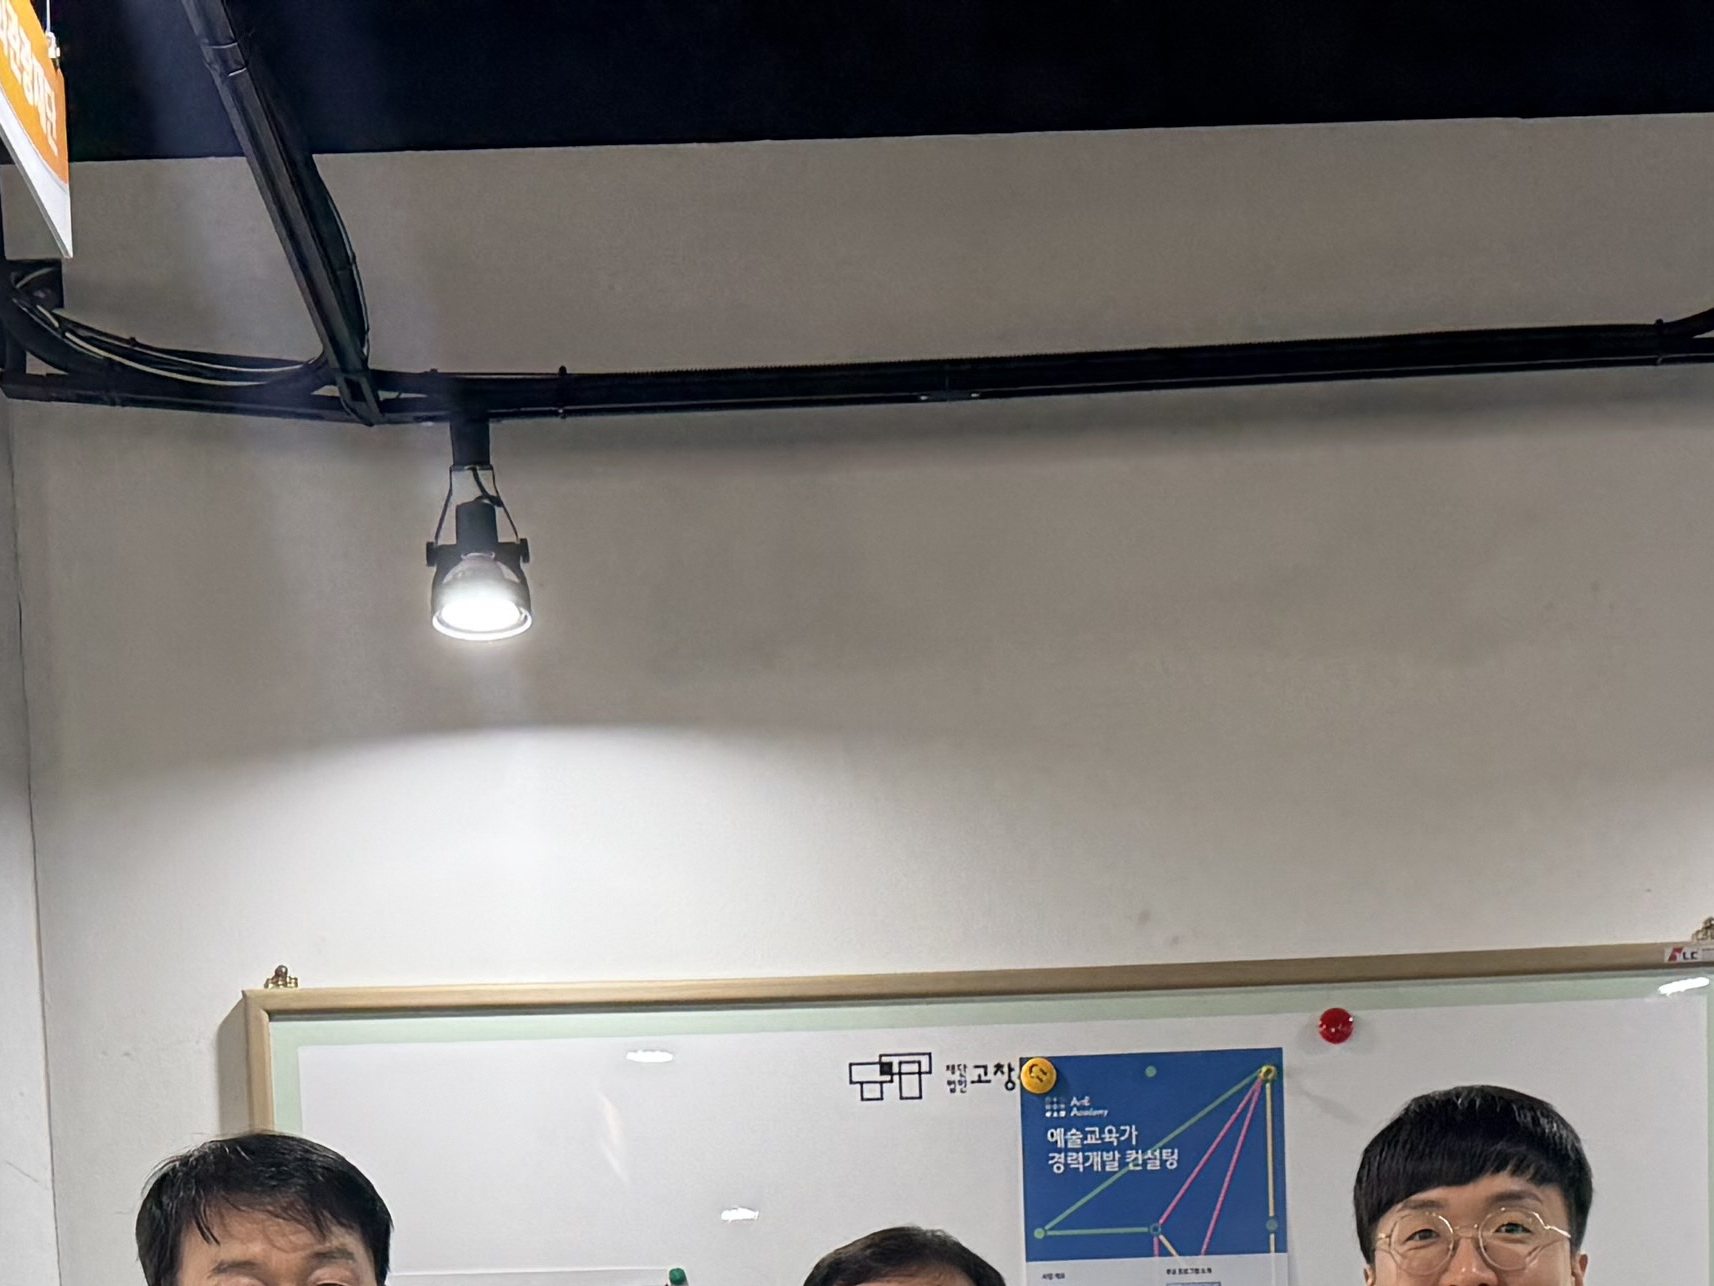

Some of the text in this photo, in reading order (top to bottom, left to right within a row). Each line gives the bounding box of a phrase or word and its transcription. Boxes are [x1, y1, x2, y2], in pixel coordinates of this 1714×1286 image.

[970, 1062, 1020, 1091] 고창
[1047, 1125, 1138, 1149] 예술교육가
[1048, 1148, 1179, 1173] 경력개발 컨설팅
